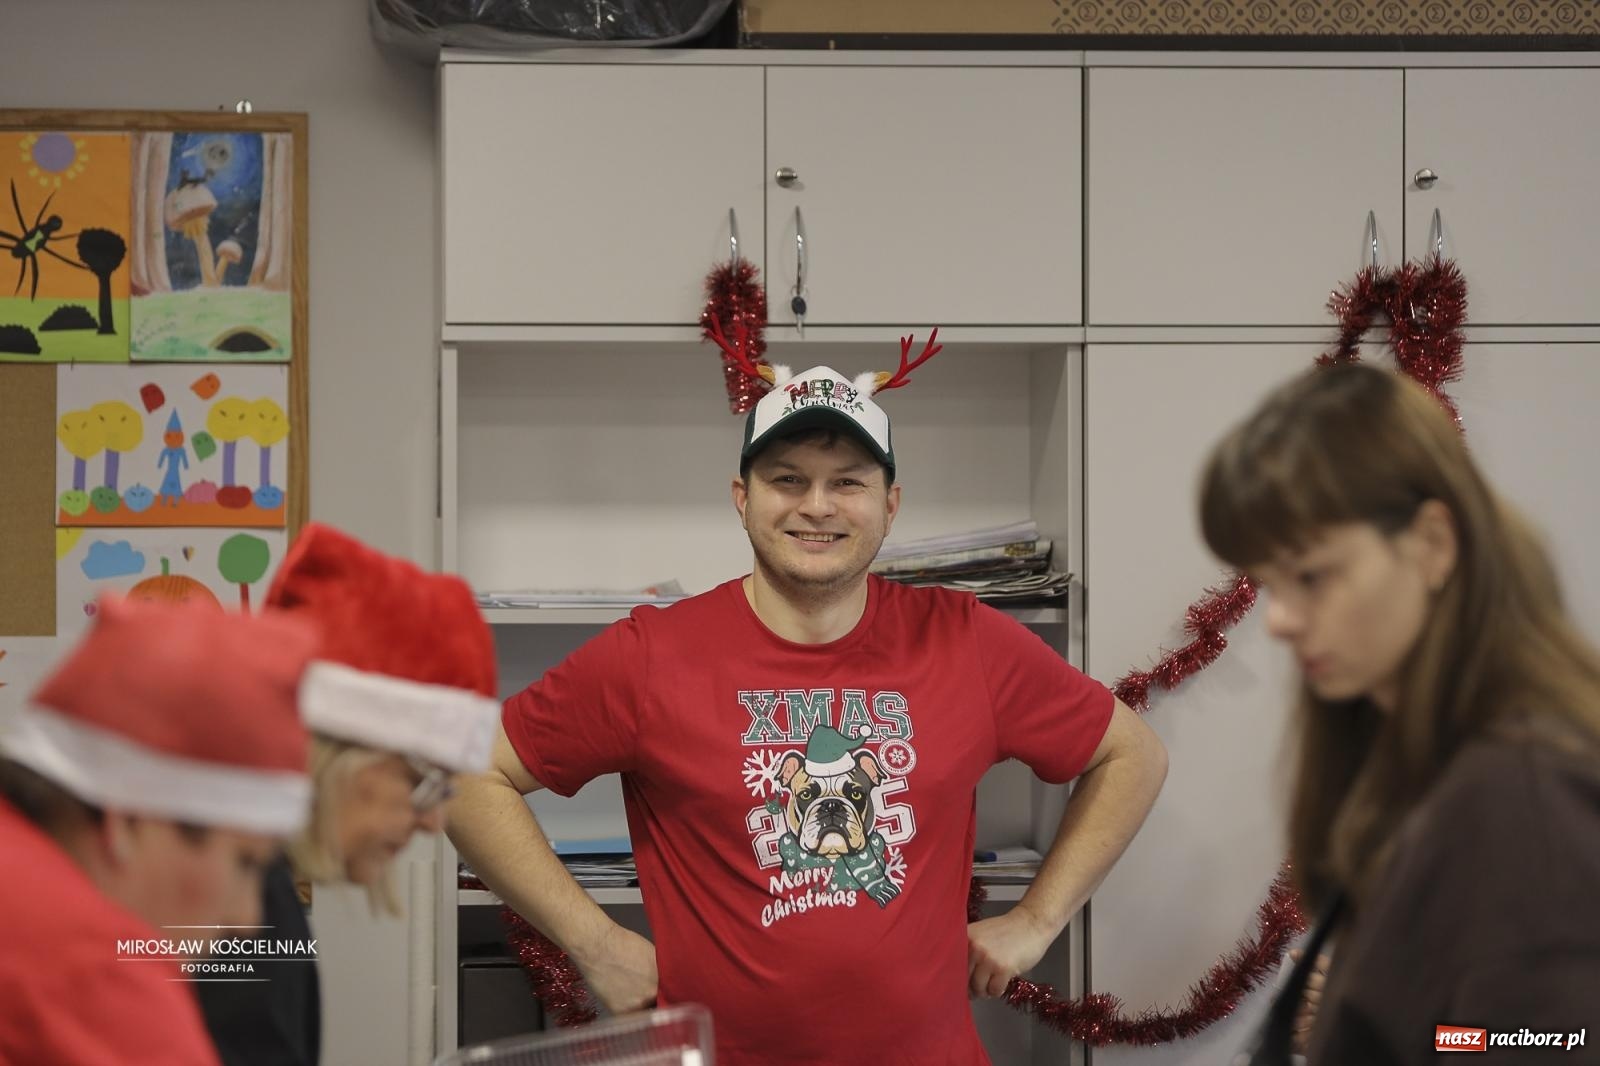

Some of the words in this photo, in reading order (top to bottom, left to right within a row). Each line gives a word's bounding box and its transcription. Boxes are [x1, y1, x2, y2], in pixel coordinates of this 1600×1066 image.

[785, 378, 858, 404] MERRY
[738, 688, 914, 745] XMAS
[768, 865, 836, 895] Merry
[761, 889, 858, 928] Christmas
